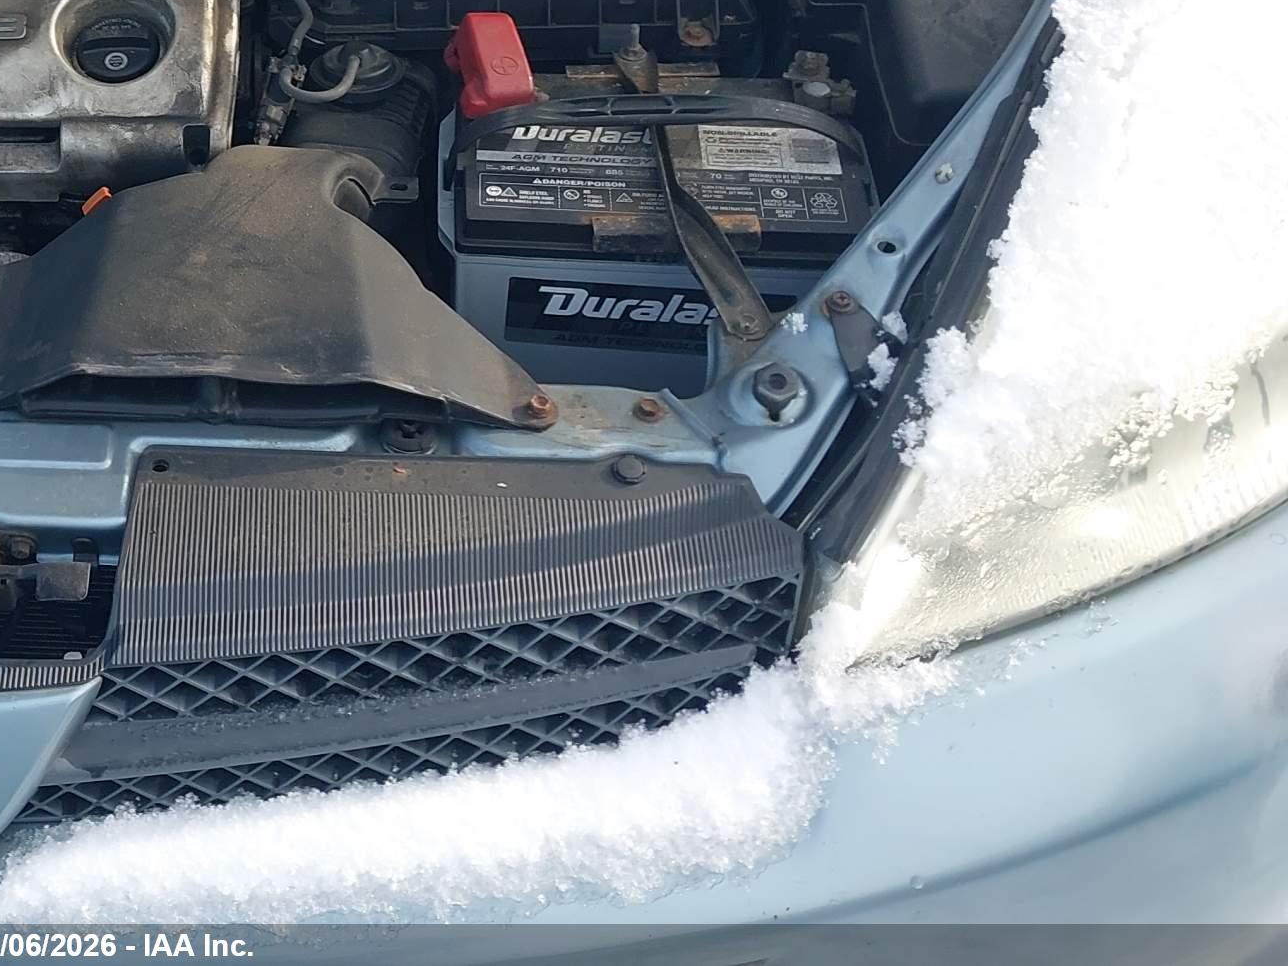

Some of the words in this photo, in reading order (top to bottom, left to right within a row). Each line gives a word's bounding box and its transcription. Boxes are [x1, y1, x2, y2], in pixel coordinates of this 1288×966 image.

[511, 153, 546, 161] AGM
[551, 155, 654, 165] TECHNOLOGY
[542, 178, 626, 188] DANGER/POISON
